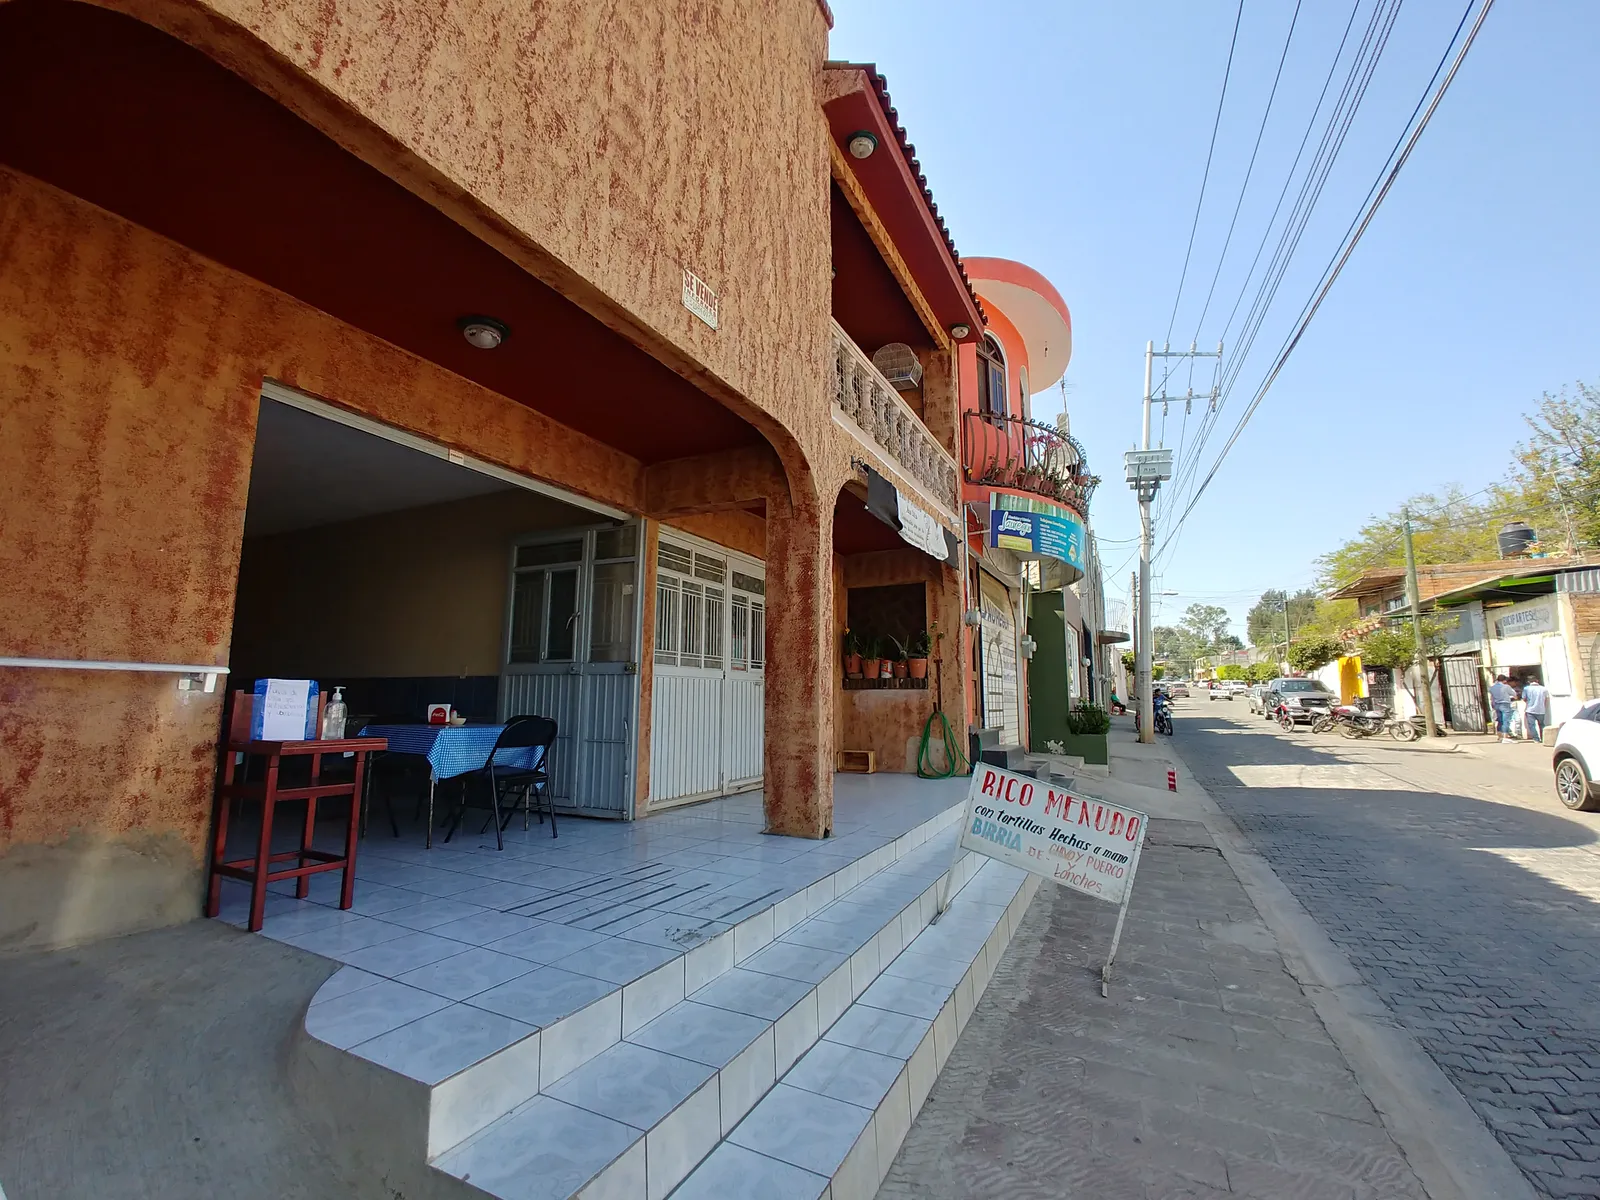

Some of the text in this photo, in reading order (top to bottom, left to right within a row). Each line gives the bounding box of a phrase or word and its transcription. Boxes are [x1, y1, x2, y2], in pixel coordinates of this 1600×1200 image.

[684, 272, 694, 291] SE
[695, 278, 717, 312] VENDE
[974, 805, 1129, 864] con tortillas Hechas a mano
[981, 770, 1141, 842] RICO MENUDO
[971, 816, 1022, 853] BIRRIA
[1086, 856, 1124, 879] PUERCO
[1054, 863, 1103, 893] Lonches
